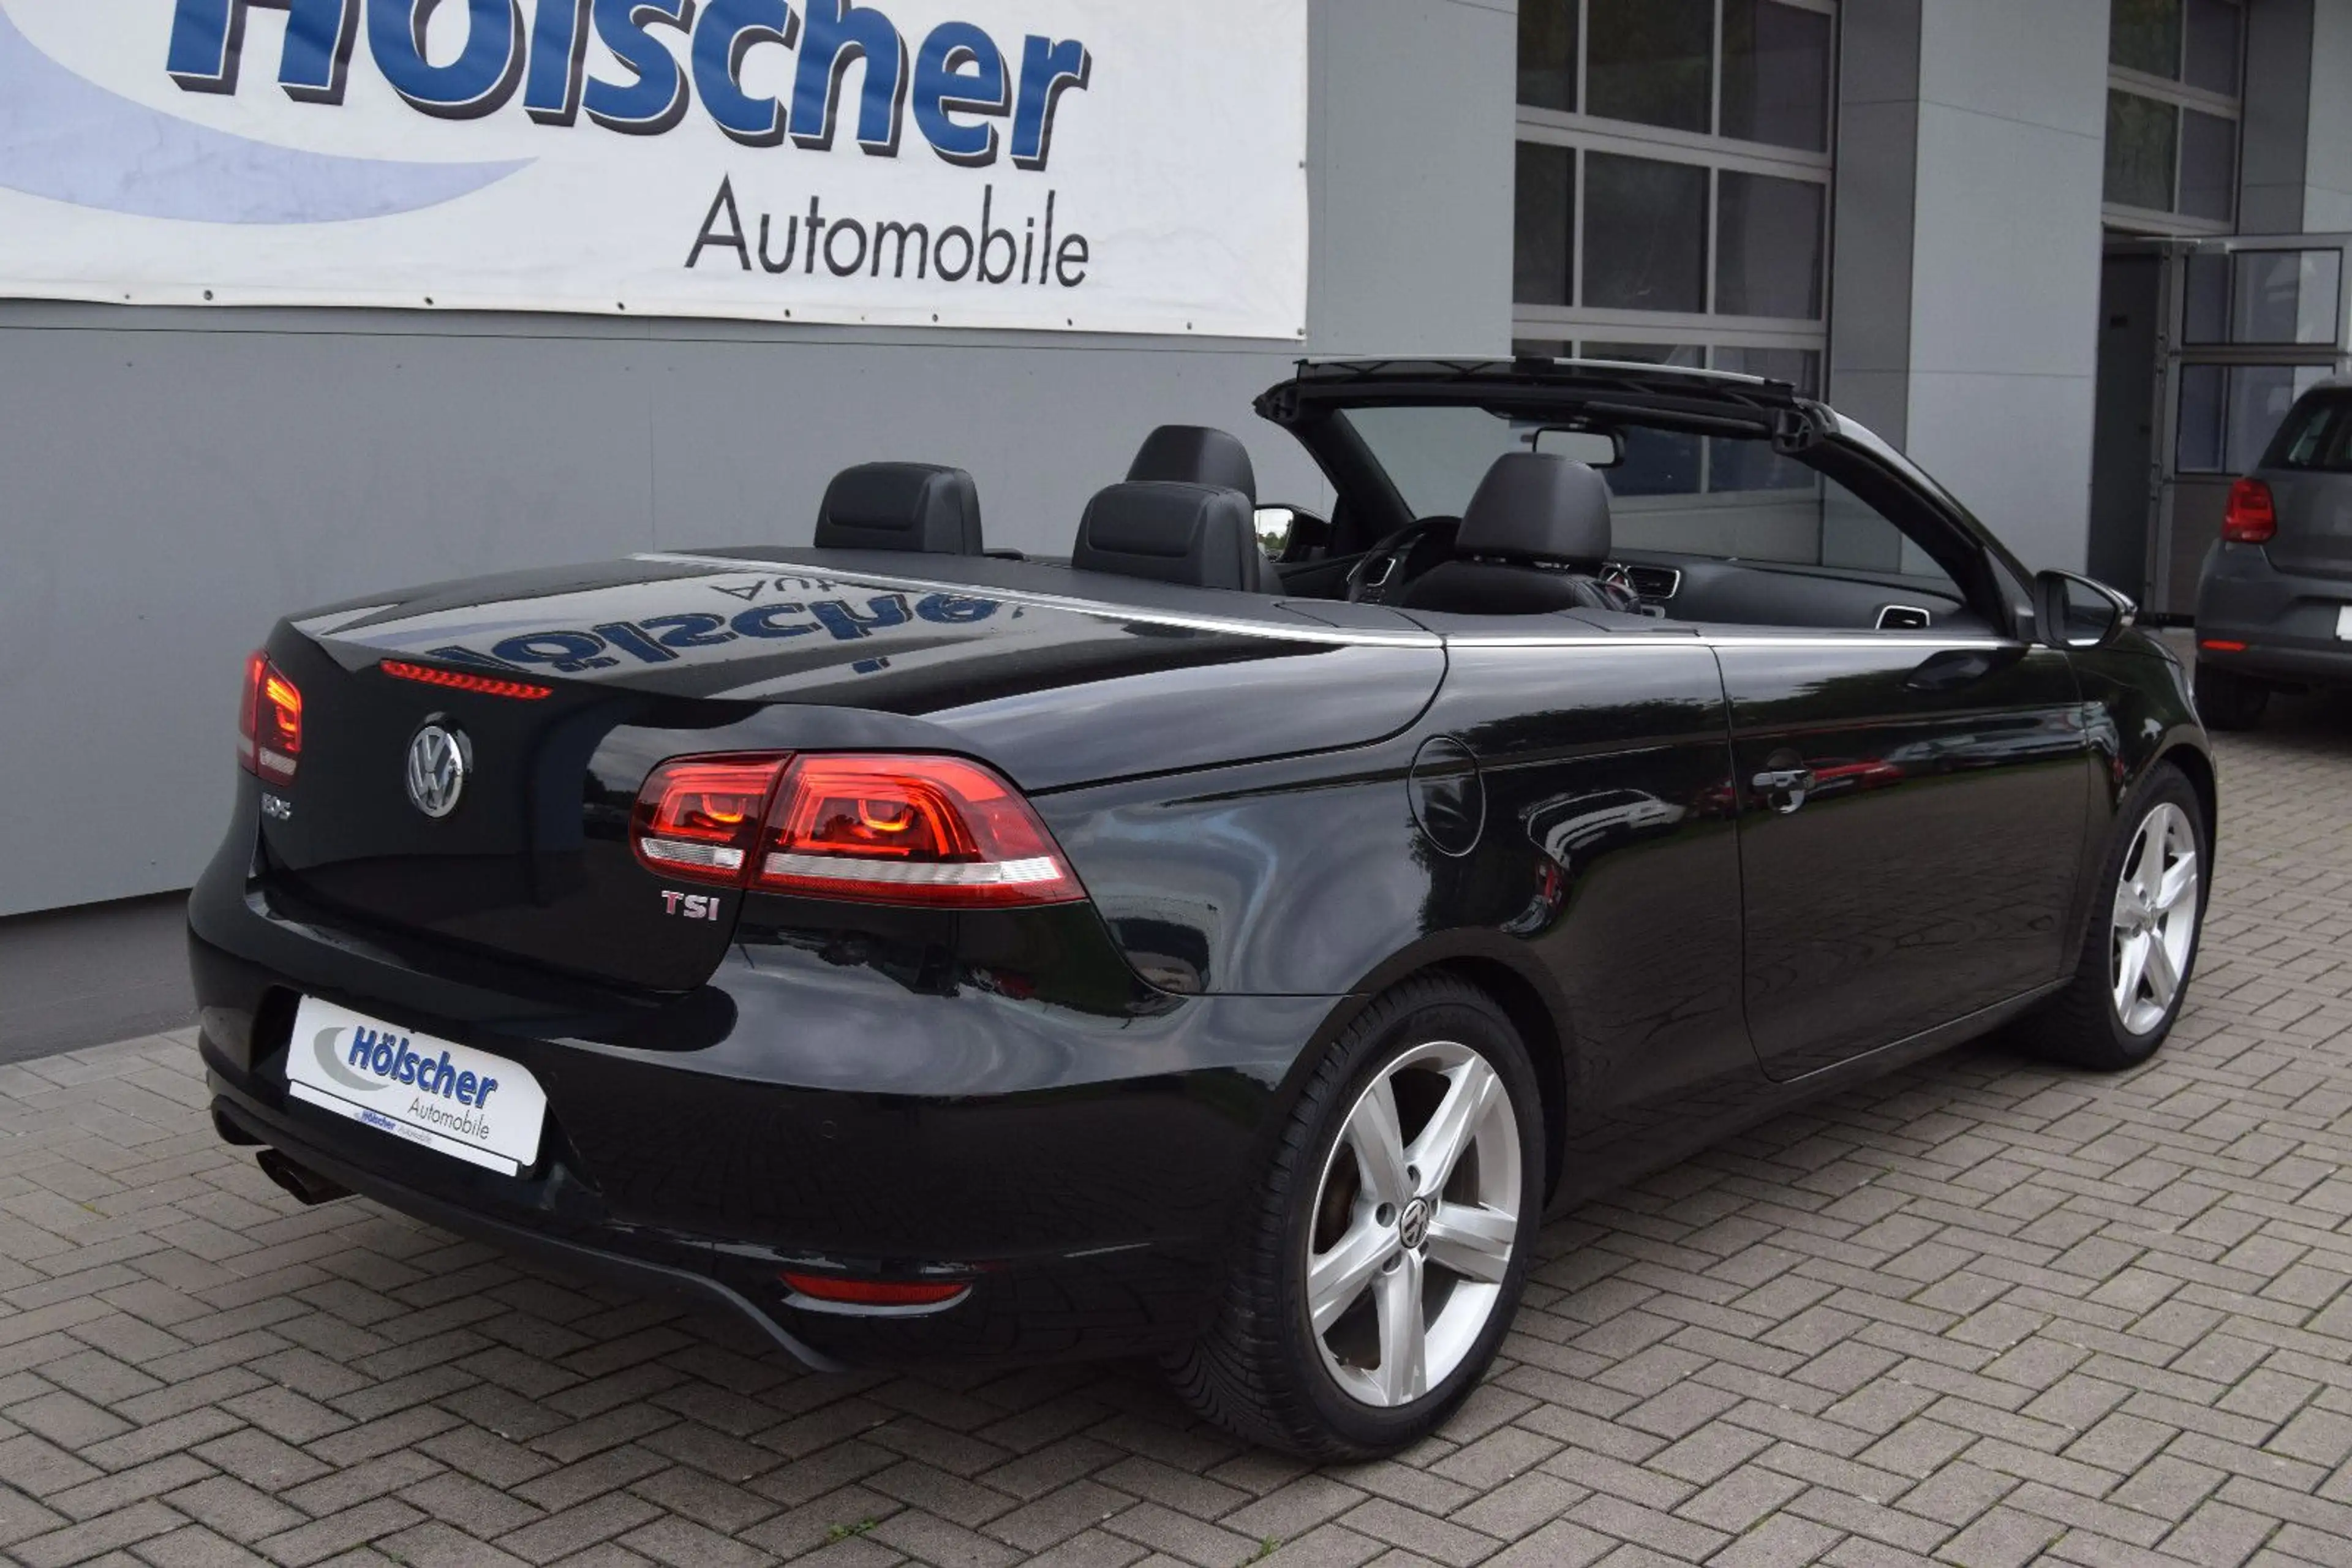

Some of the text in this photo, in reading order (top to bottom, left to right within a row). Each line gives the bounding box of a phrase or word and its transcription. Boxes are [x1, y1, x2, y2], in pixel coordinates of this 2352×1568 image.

[684, 172, 1089, 287] Automobile
[662, 890, 720, 921] TSI
[348, 1025, 498, 1109] Hölscher
[407, 1096, 490, 1140] Automobile
